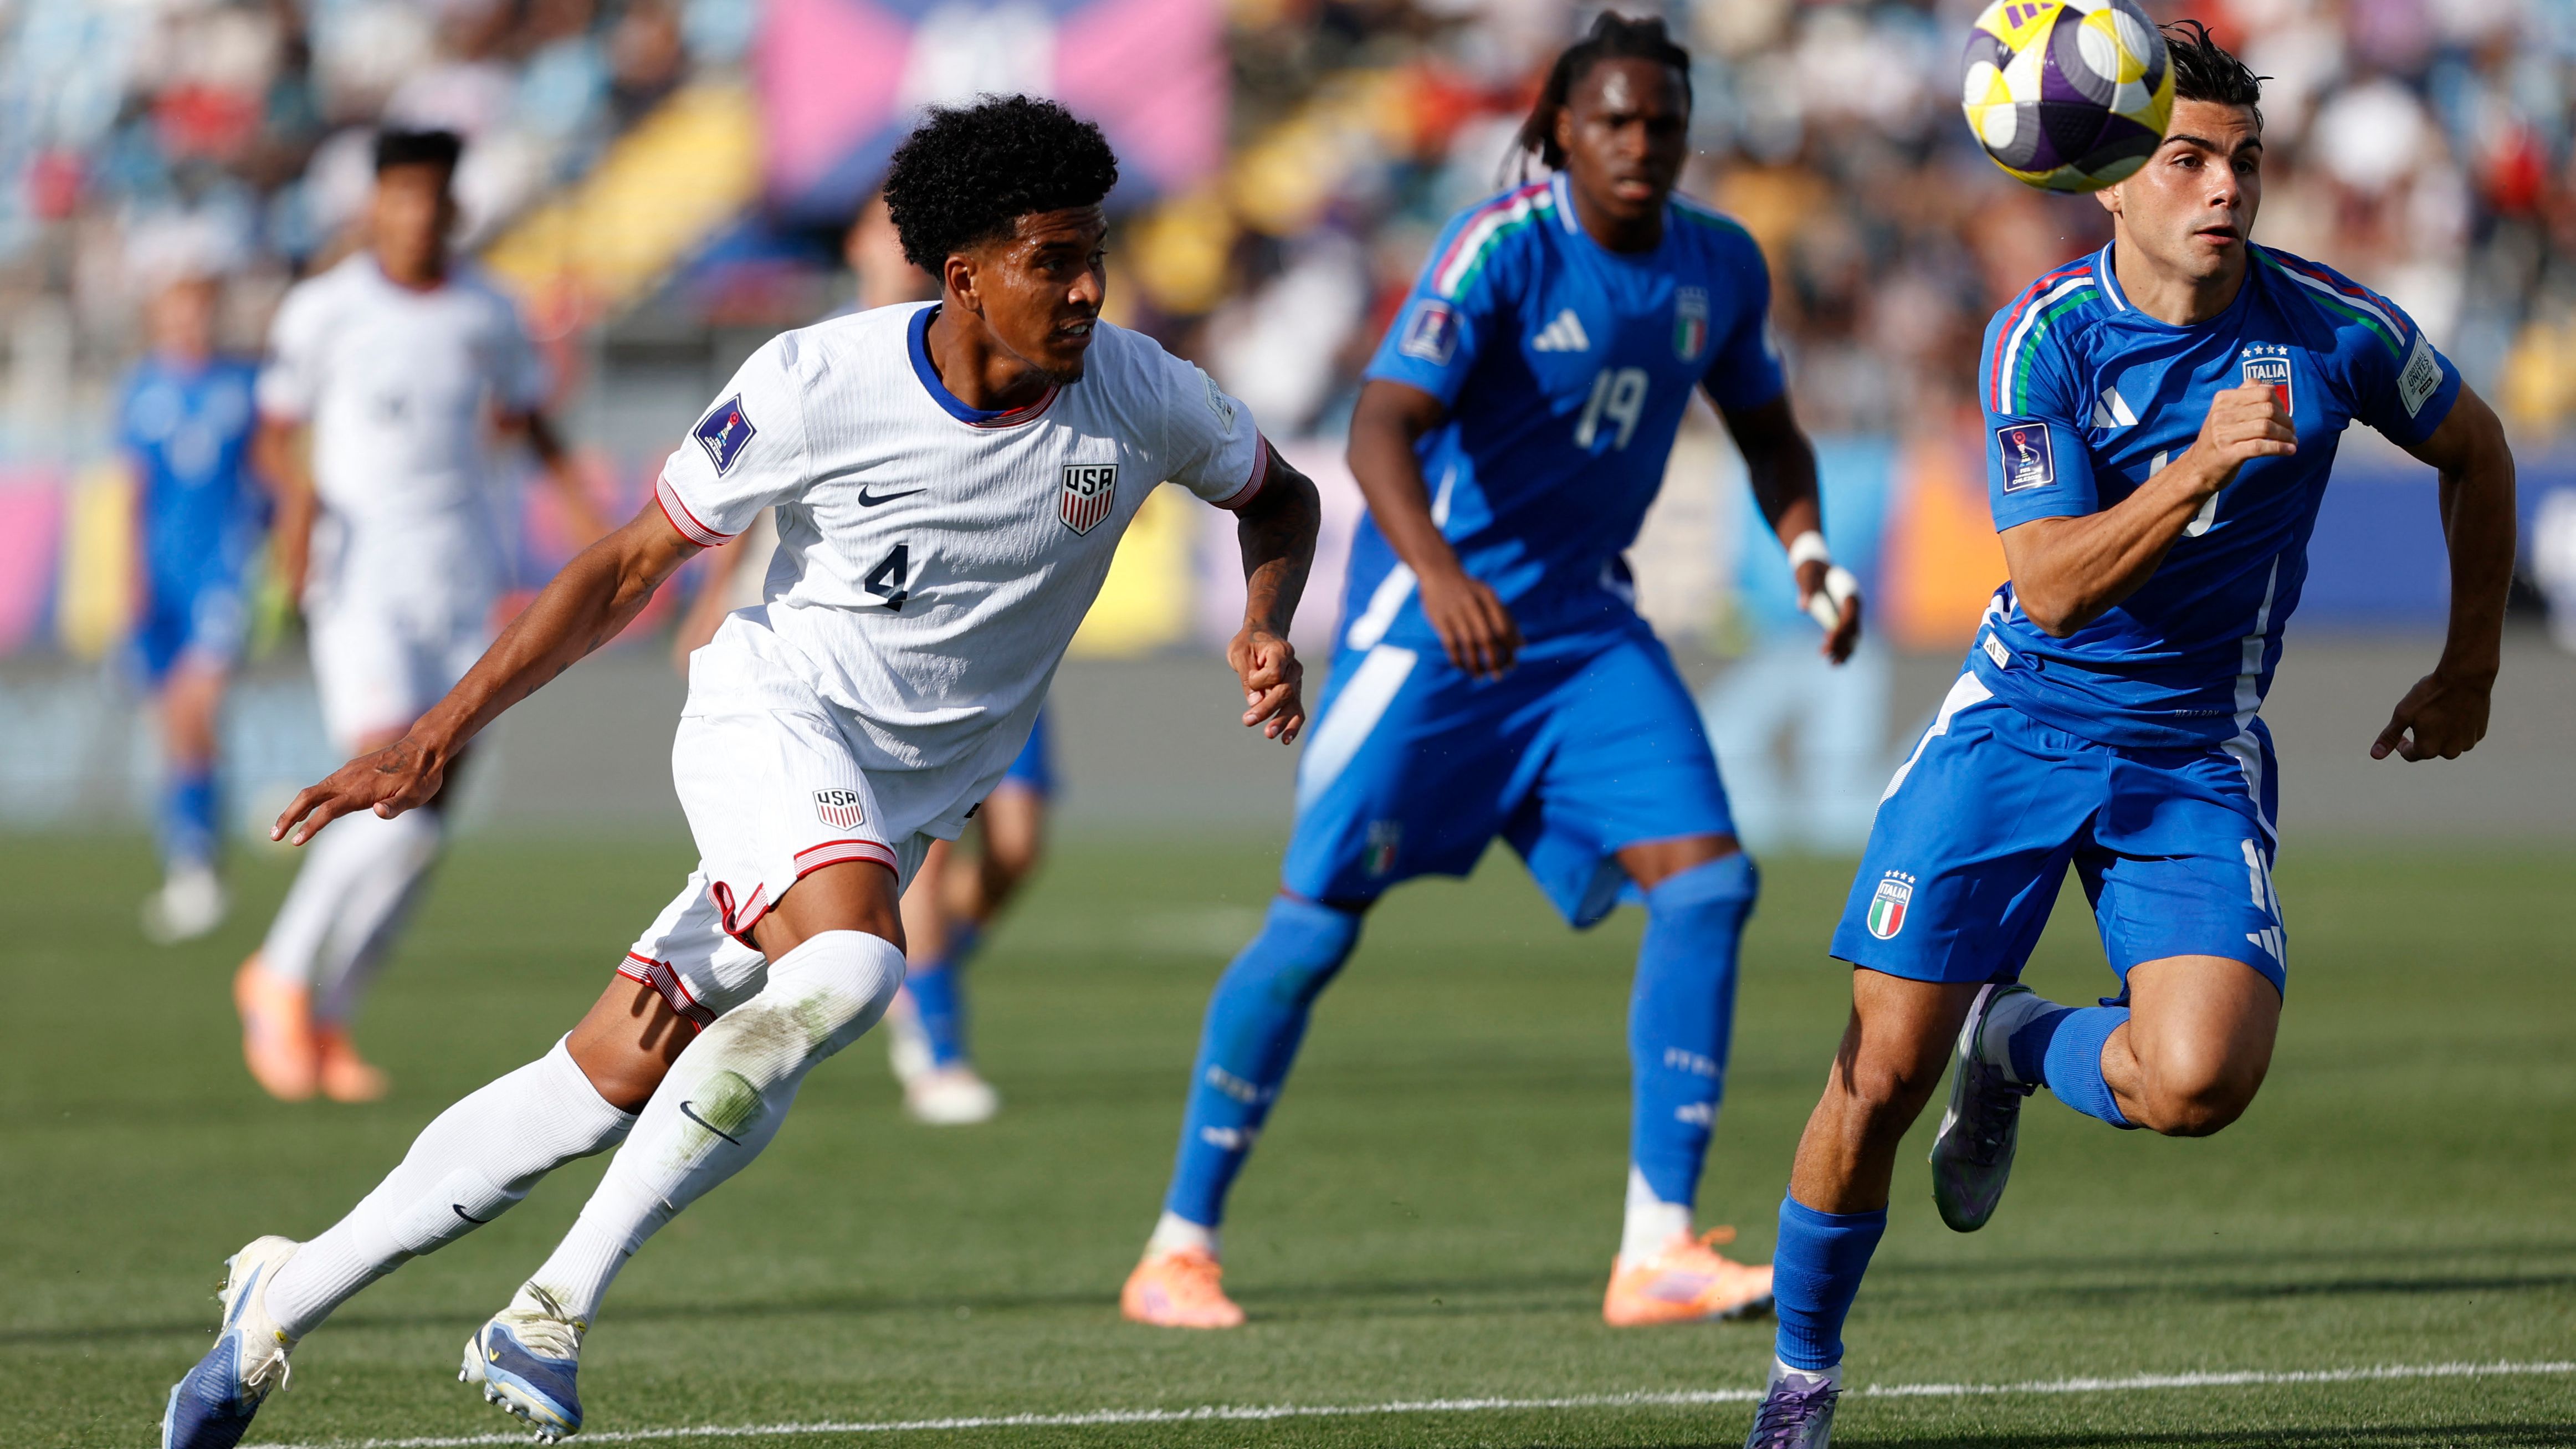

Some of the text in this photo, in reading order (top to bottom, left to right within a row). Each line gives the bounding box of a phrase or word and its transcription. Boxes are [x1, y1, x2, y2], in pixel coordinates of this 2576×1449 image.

[2247, 364, 2286, 378] ITALIA
[2406, 351, 2425, 380] FOOTBALL
[2409, 356, 2429, 387] UNITES
[1575, 367, 1649, 449] 19
[1066, 468, 1113, 496] USA
[865, 545, 908, 612] 4
[817, 791, 857, 806] USA
[1879, 883, 1907, 900] ITALIA
